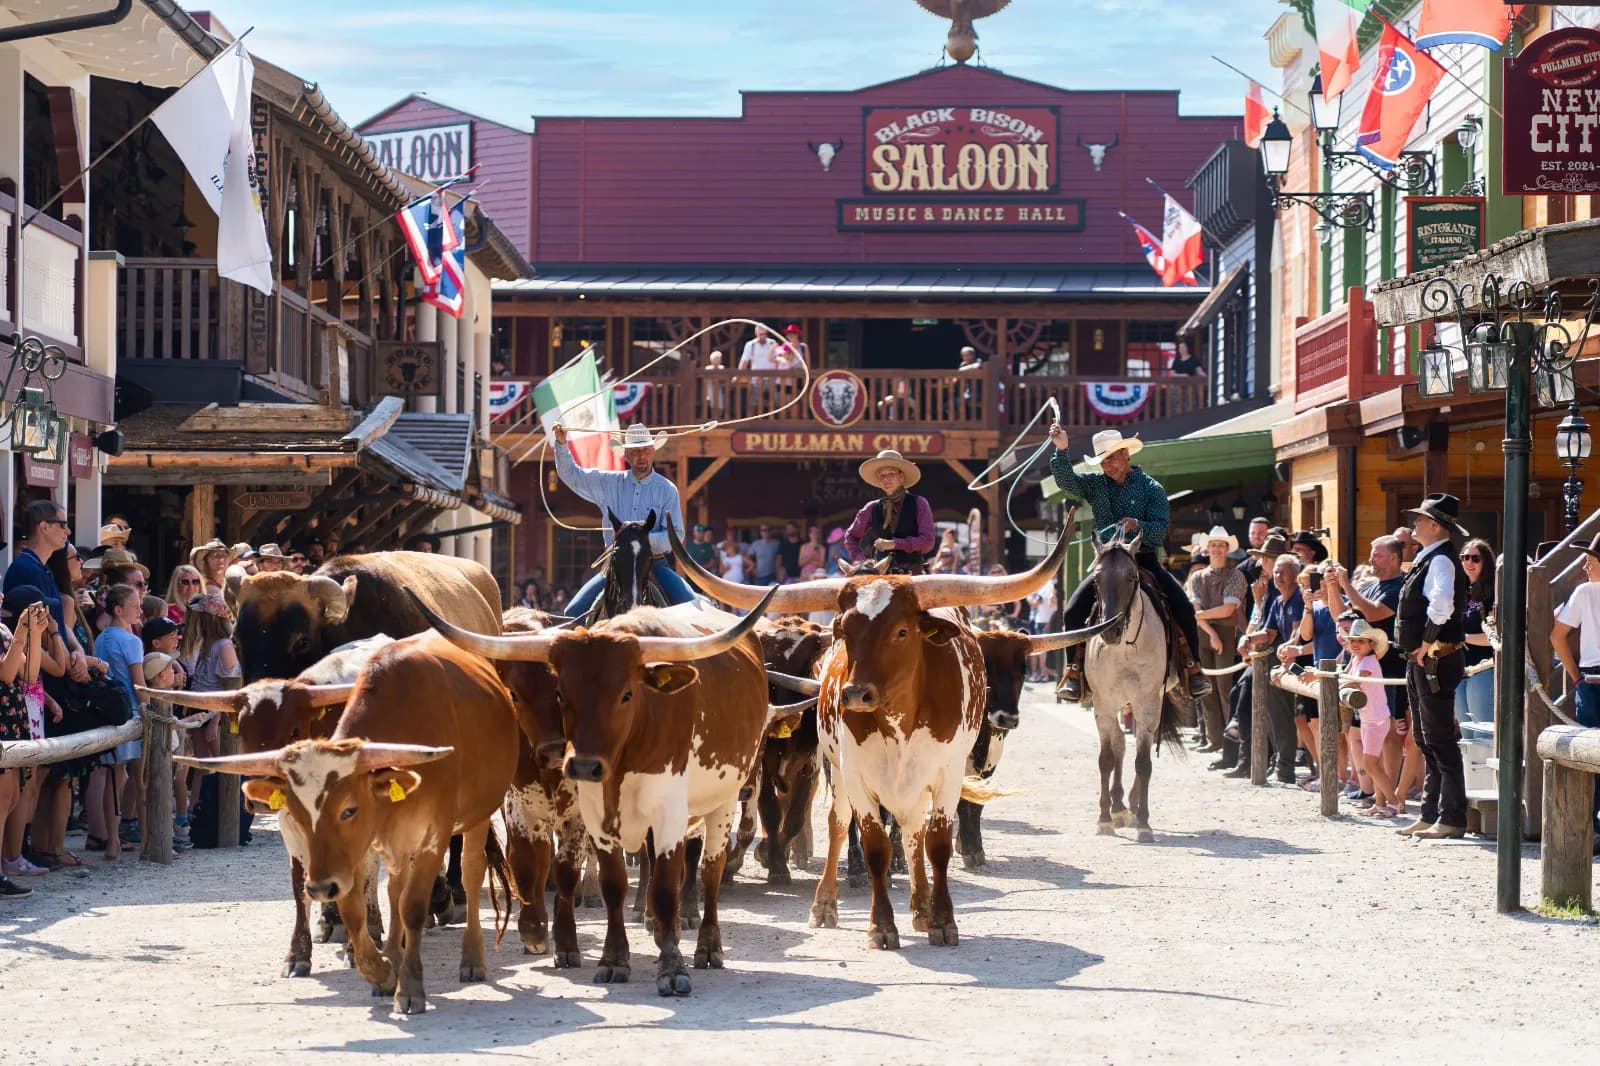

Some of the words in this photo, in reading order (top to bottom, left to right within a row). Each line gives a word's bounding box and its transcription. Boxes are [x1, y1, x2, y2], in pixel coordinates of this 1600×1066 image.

[1540, 55, 1583, 74] PULLMAN
[873, 107, 956, 144] BLACK
[969, 107, 1045, 143] BISON
[1529, 113, 1600, 153] CIT
[870, 143, 1049, 191] SALOON
[1541, 160, 1565, 171] EST.
[855, 207, 917, 221] MUSIC
[923, 207, 935, 221] &
[942, 207, 1005, 221] DANCE
[1018, 207, 1066, 221] HALL
[1417, 222, 1477, 239] RISTORANTE
[1430, 236, 1463, 244] ITALIANO
[745, 434, 864, 451] PULLMAN
[872, 434, 933, 452] CITY
